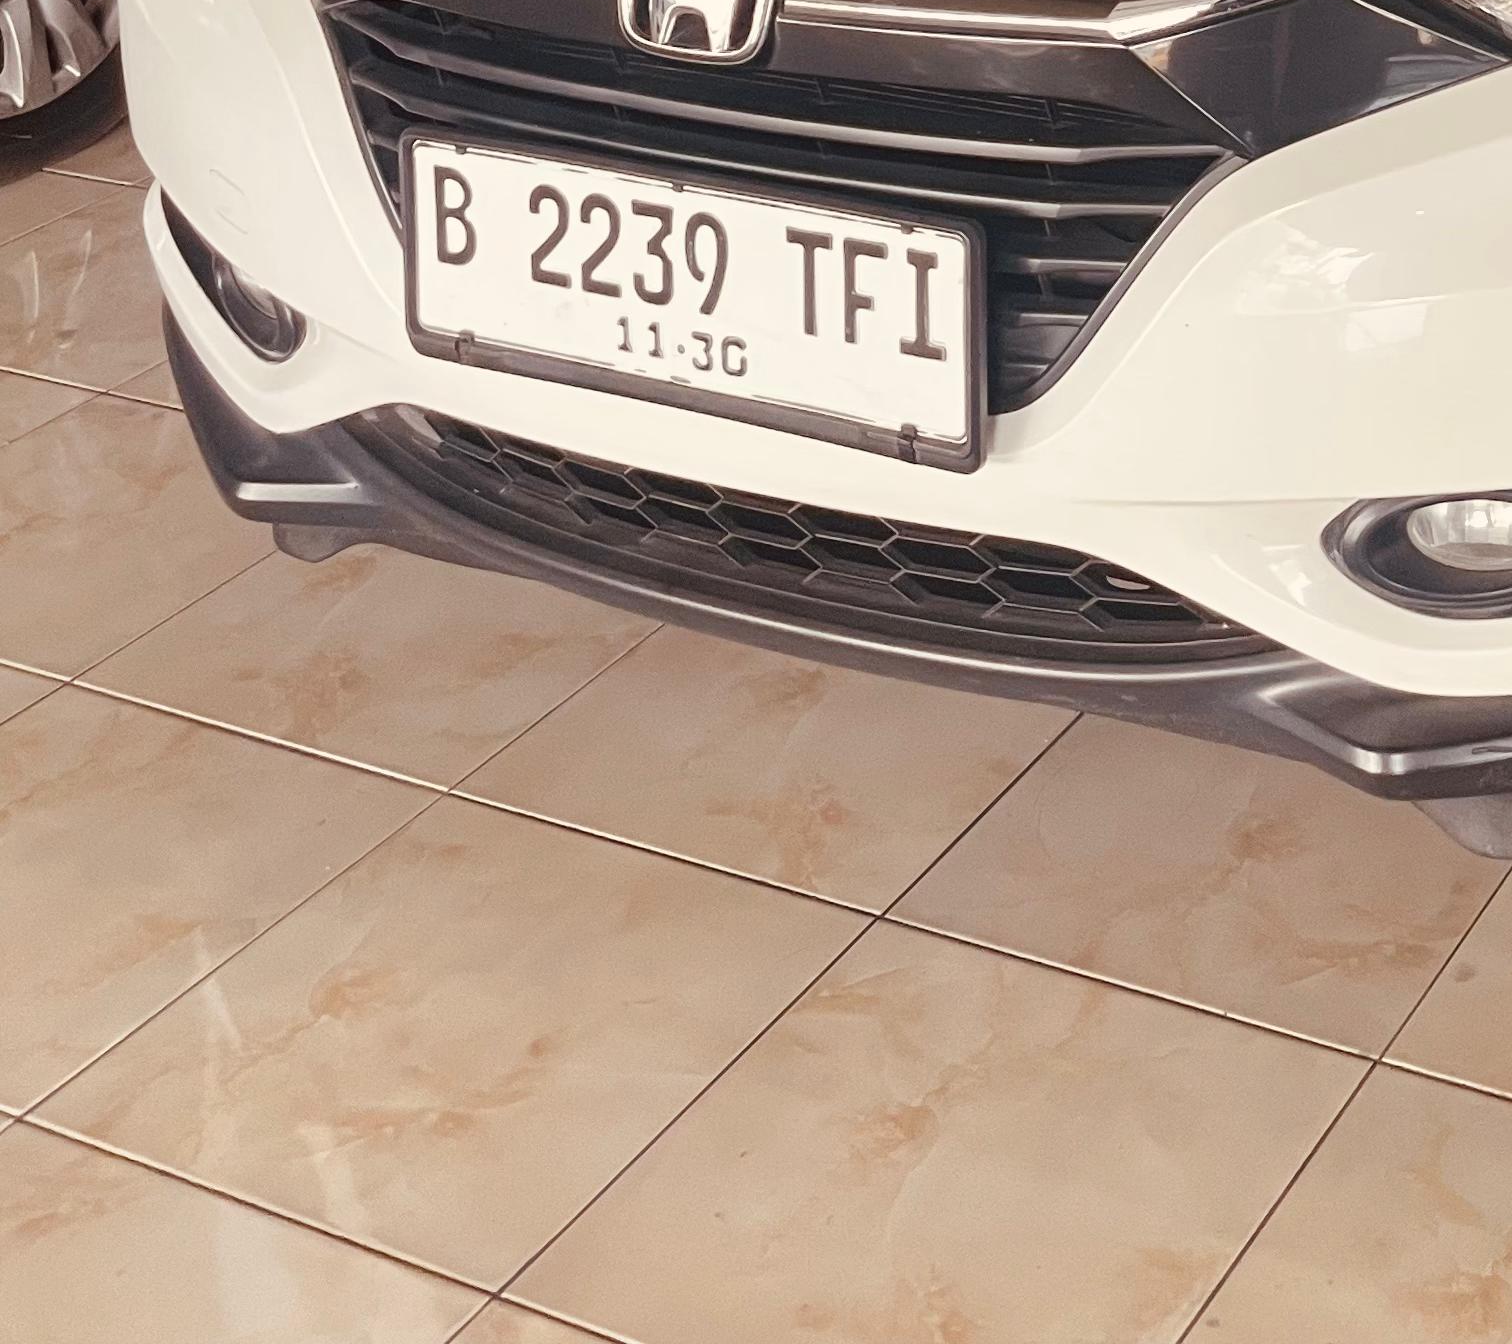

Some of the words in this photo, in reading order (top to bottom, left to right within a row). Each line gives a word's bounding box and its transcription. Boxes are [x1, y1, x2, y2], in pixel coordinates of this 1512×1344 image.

[432, 165, 478, 267] B
[528, 182, 730, 317] 2239
[784, 224, 948, 363] TFI
